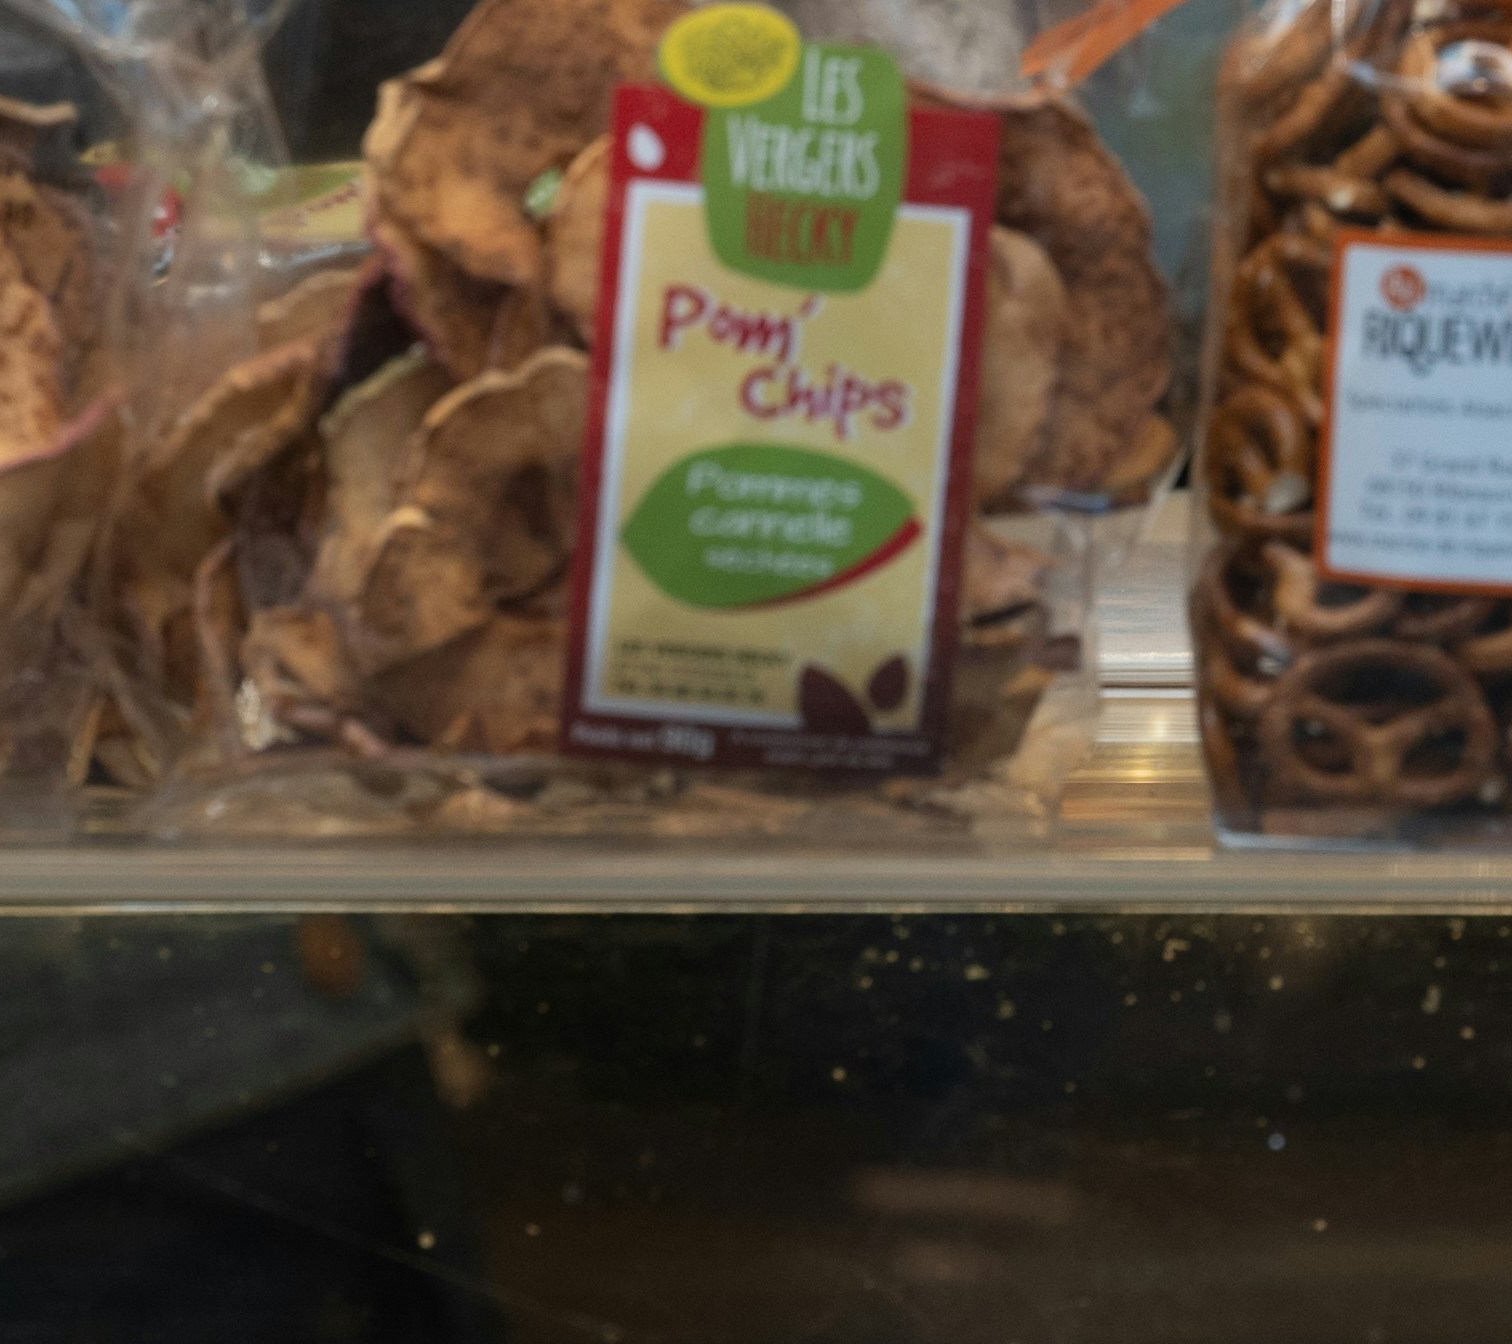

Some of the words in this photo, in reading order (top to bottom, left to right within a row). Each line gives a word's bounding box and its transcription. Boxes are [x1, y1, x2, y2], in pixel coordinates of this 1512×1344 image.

[800, 45, 865, 125] LES
[724, 113, 881, 202] VERGERS
[738, 363, 915, 443] Chips
